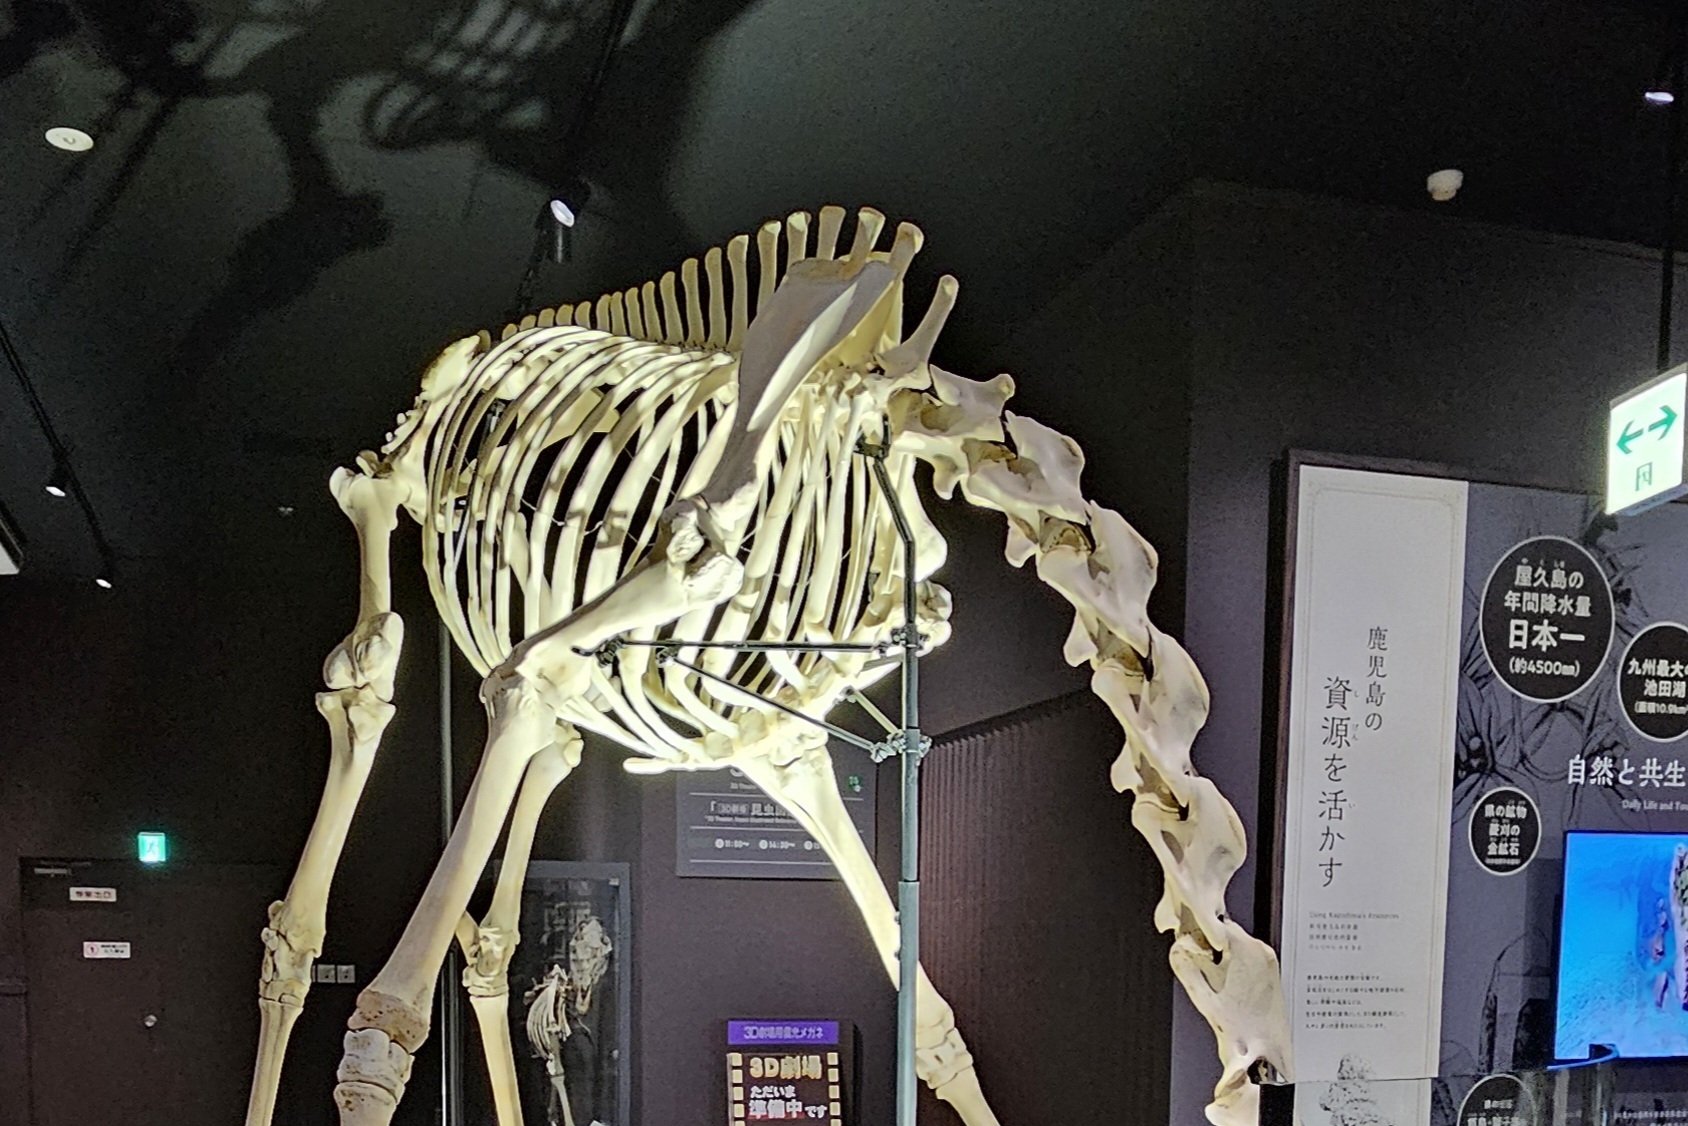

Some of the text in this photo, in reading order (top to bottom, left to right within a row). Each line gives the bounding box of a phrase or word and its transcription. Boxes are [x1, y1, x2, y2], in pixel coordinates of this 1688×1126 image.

[1514, 565, 1584, 590] 屋久島の
[1504, 590, 1591, 617] 年間降水量
[1509, 619, 1585, 652] 日本一
[1365, 626, 1388, 731] 鹿児島の
[1643, 679, 1687, 698] 池田湖
[1318, 676, 1352, 888] 資源を活かす
[1568, 754, 1687, 788] 自然と共生
[750, 1055, 822, 1080] 3D劇場
[750, 1085, 797, 1099] ただいま
[749, 1099, 828, 1119] 準備中です
